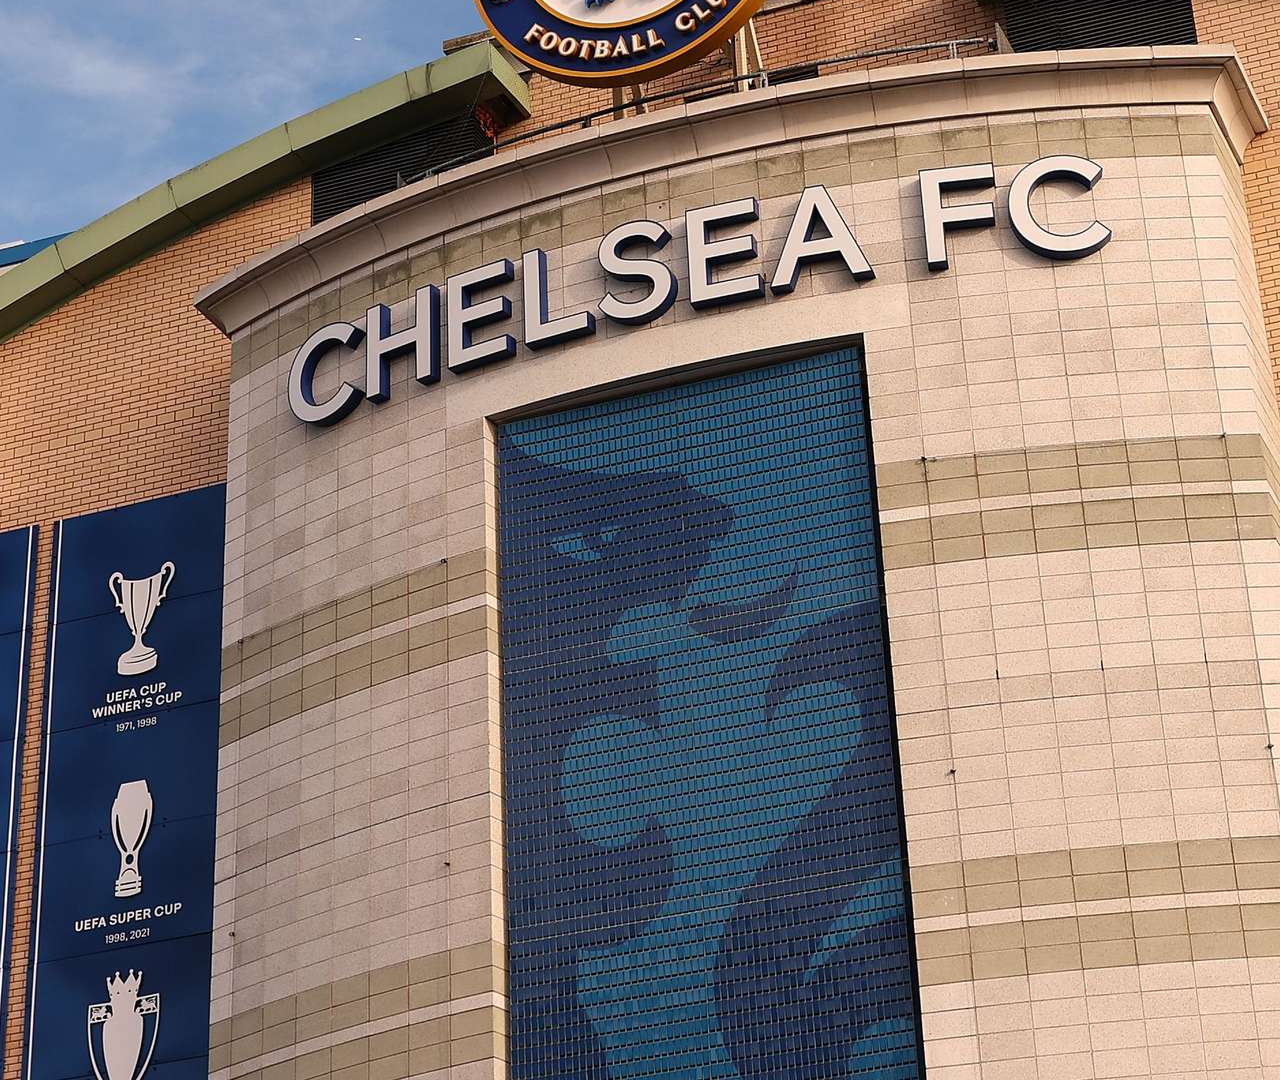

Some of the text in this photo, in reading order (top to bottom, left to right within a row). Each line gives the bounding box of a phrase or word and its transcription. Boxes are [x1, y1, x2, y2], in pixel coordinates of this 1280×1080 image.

[523, 24, 665, 61] FOOTBALL
[287, 154, 1113, 427] CHELSEA FC
[92, 691, 183, 719] WINNER'S CUP
[106, 682, 167, 703] UEFA CUP
[116, 717, 157, 732] 1971, 1998
[75, 902, 182, 932] UEFA SUPER CUP
[105, 927, 150, 944] 1998, 2021
